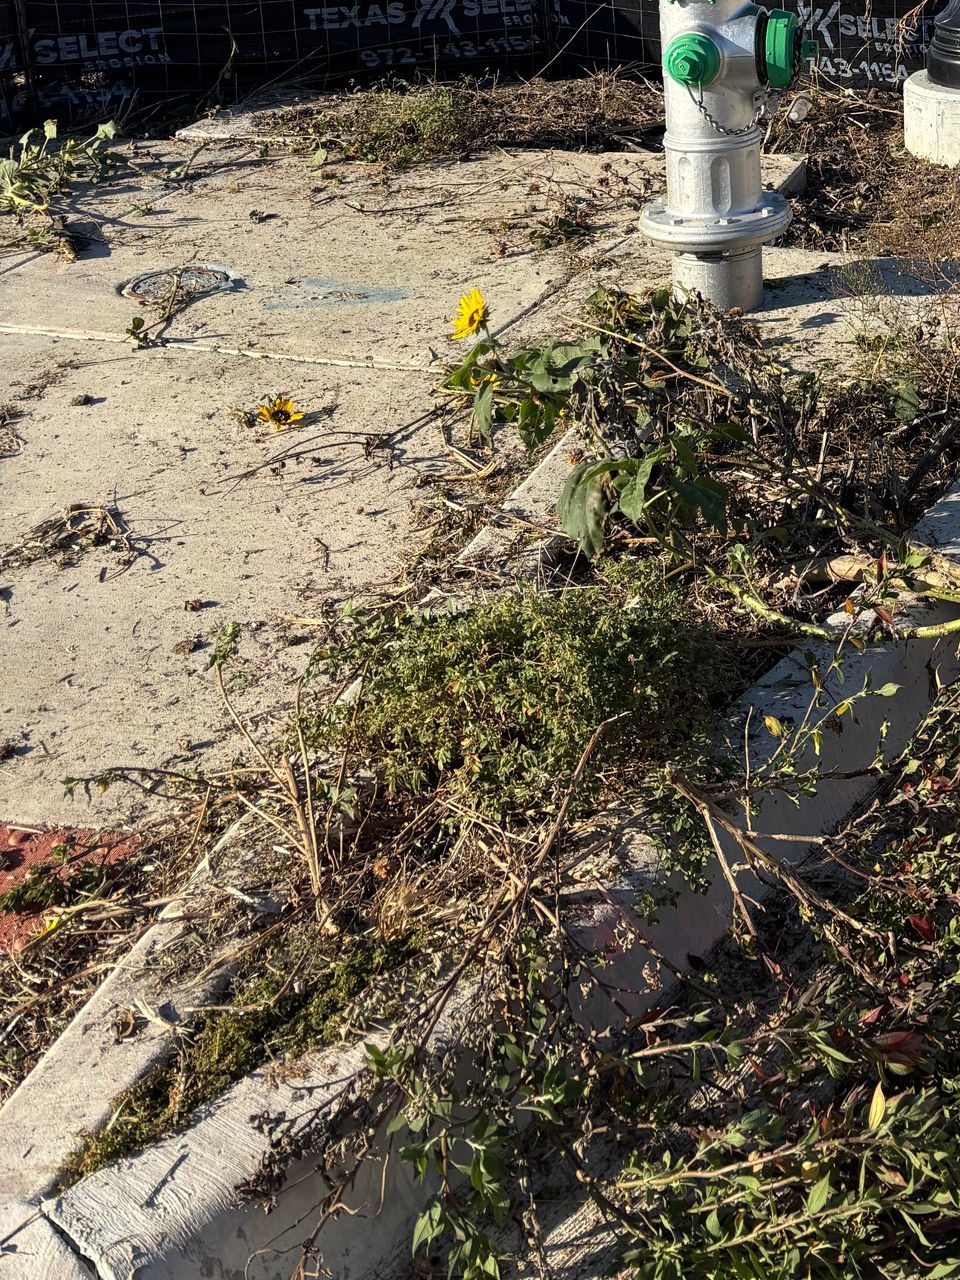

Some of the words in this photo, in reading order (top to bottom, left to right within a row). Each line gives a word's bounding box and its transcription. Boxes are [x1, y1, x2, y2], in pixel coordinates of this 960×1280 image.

[303, 1, 407, 31] TEXAS
[501, 12, 570, 26] EROON
[33, 27, 163, 65] SELECT
[873, 42, 929, 58] EROSIO
